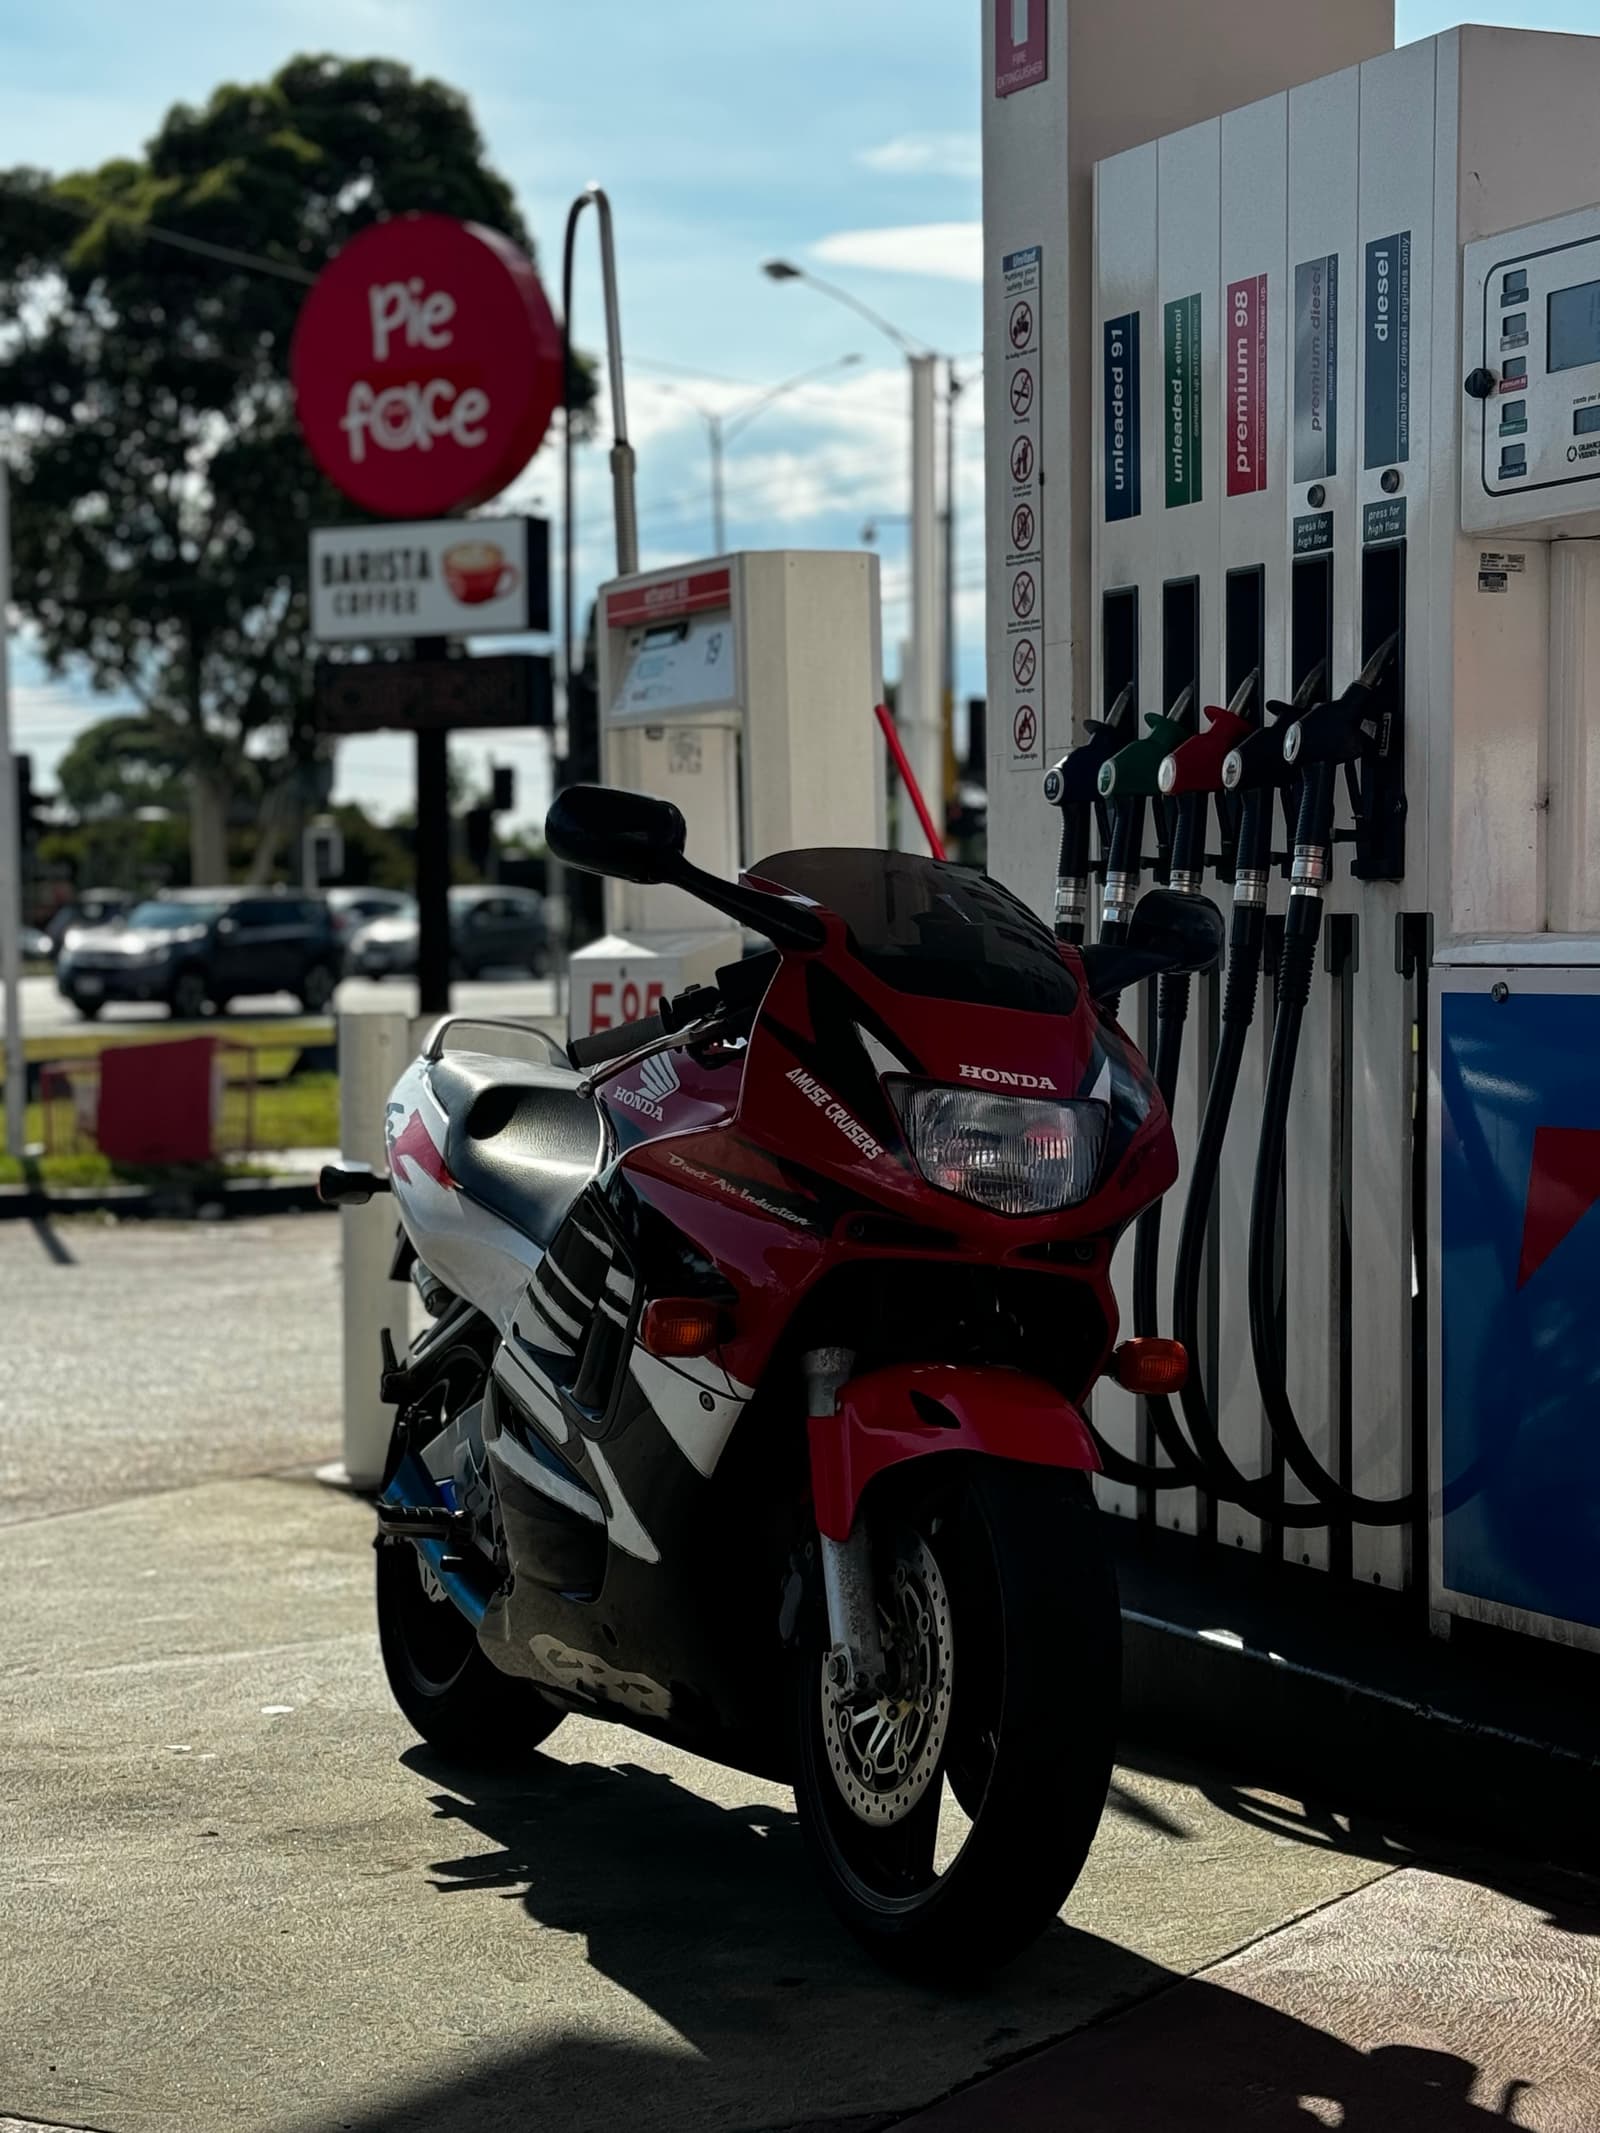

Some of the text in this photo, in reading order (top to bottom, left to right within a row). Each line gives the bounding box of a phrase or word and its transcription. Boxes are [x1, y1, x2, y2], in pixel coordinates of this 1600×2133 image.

[1374, 251, 1389, 341] diesel
[1174, 308, 1182, 364] ethanol
[1310, 265, 1323, 432] premium diesel
[1400, 237, 1411, 444] suitable for diesel engines only
[1235, 291, 1251, 473] premium 98
[338, 377, 490, 465] face
[1111, 328, 1124, 490] unleaded 91
[1172, 379, 1183, 483] unleaded
[1297, 519, 1328, 535] press for
[1368, 505, 1401, 523] press for
[1368, 520, 1400, 537] high flow
[1297, 536, 1313, 549] high
[321, 549, 433, 588] BARISTA
[333, 590, 418, 617] COFFEE
[958, 1063, 1058, 1091] HONDA
[613, 1086, 664, 1122] HONDA
[785, 1067, 885, 1160] AMUSE CRUISERS
[739, 1188, 814, 1226] Induction
